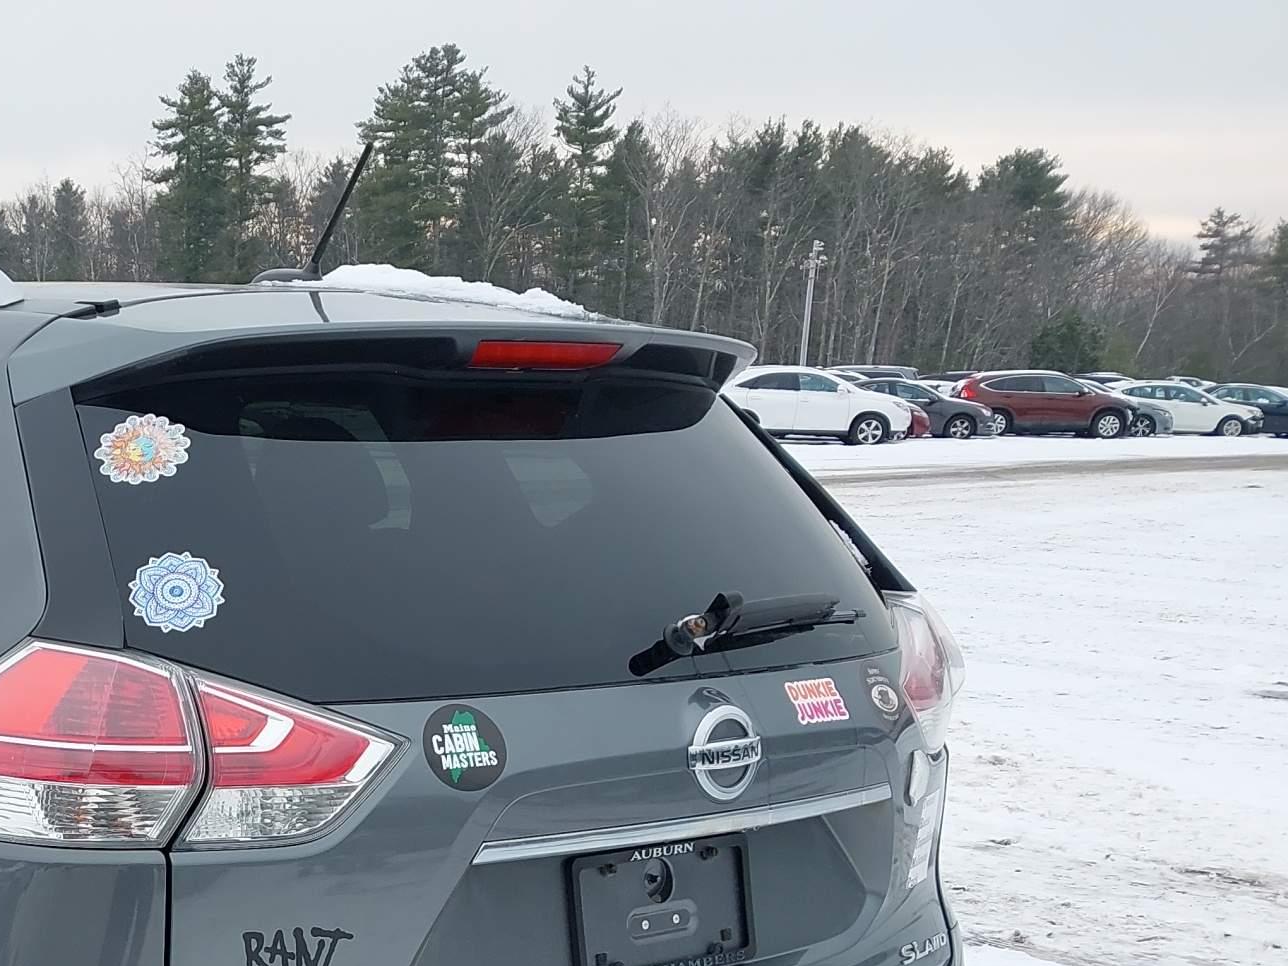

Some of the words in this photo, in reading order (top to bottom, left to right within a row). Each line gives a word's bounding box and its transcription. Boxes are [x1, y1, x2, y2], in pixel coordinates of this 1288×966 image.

[787, 680, 837, 701] DUNKIE
[797, 699, 847, 721] JUNKIE
[432, 732, 480, 755] CABIN
[701, 741, 759, 765] NISSAN
[440, 750, 498, 770] MASTERS
[630, 842, 695, 862] AUBURN
[900, 941, 929, 965] SL
